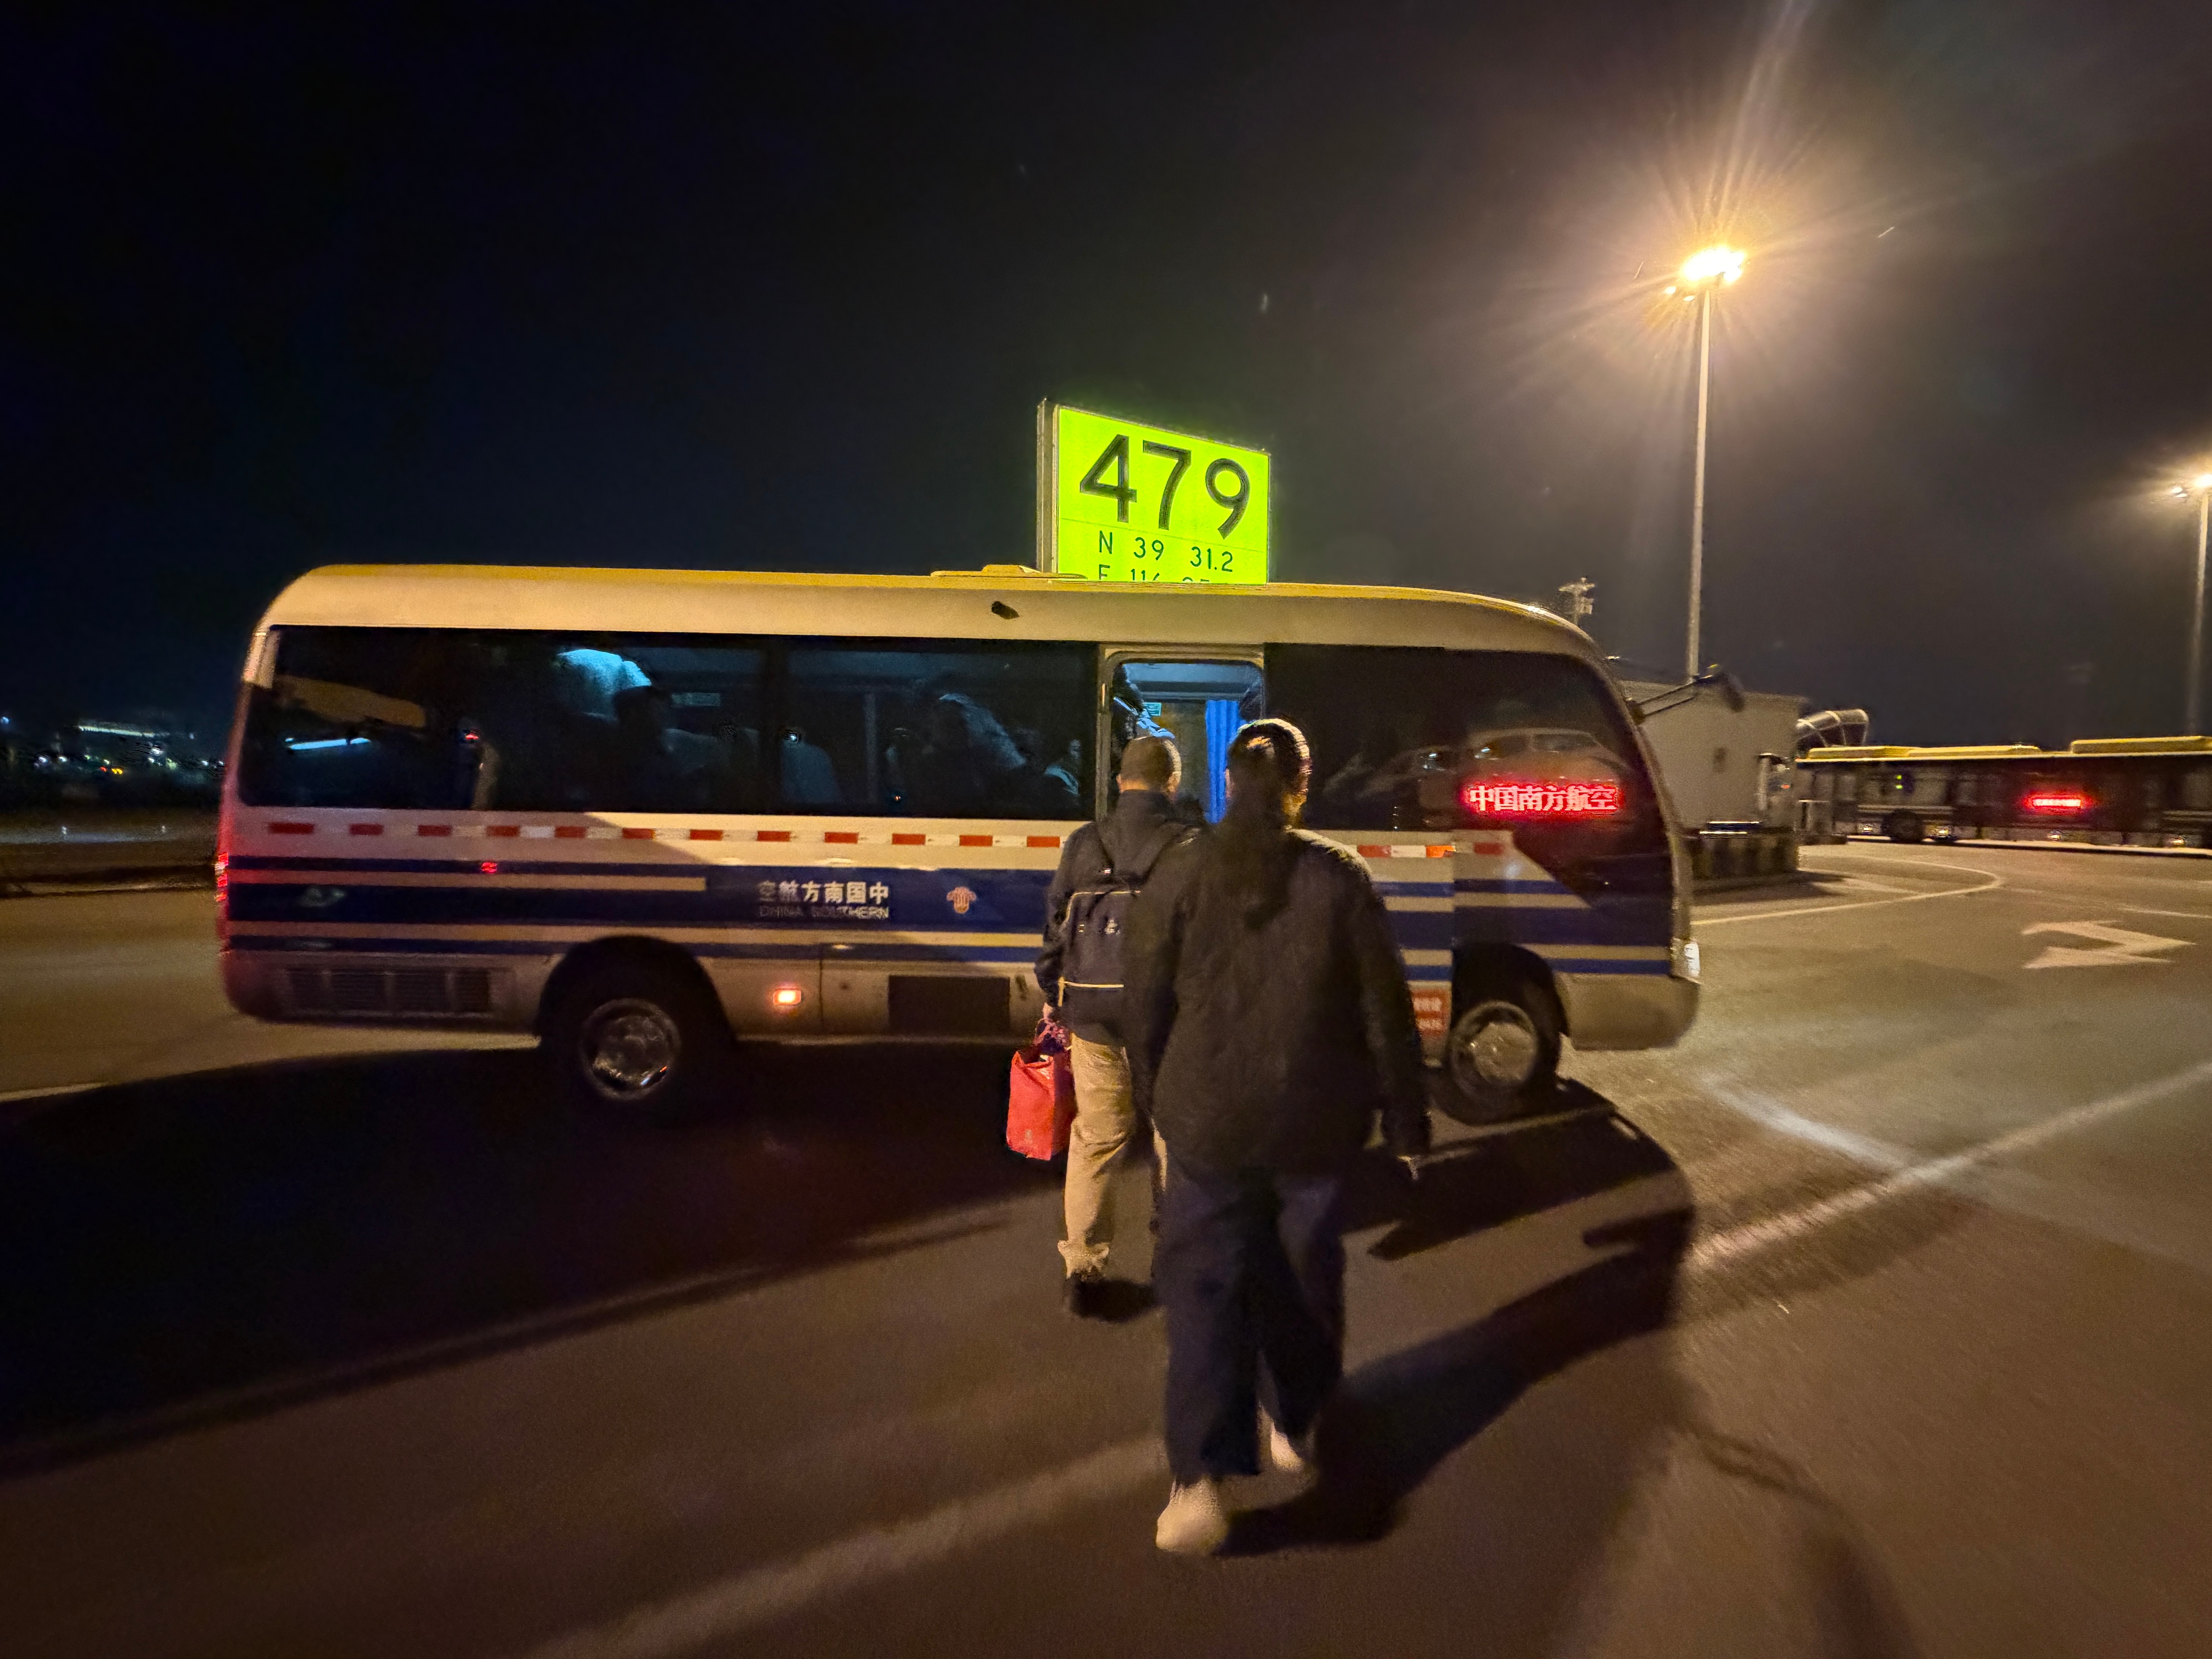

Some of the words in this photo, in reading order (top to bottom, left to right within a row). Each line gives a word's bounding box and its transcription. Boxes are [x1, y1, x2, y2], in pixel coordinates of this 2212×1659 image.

[1080, 434, 1250, 540] 479
[1099, 531, 1113, 554] N
[1133, 537, 1164, 560] 39
[1190, 546, 1233, 572] 31.2
[1470, 785, 1619, 812] 中国南方航空
